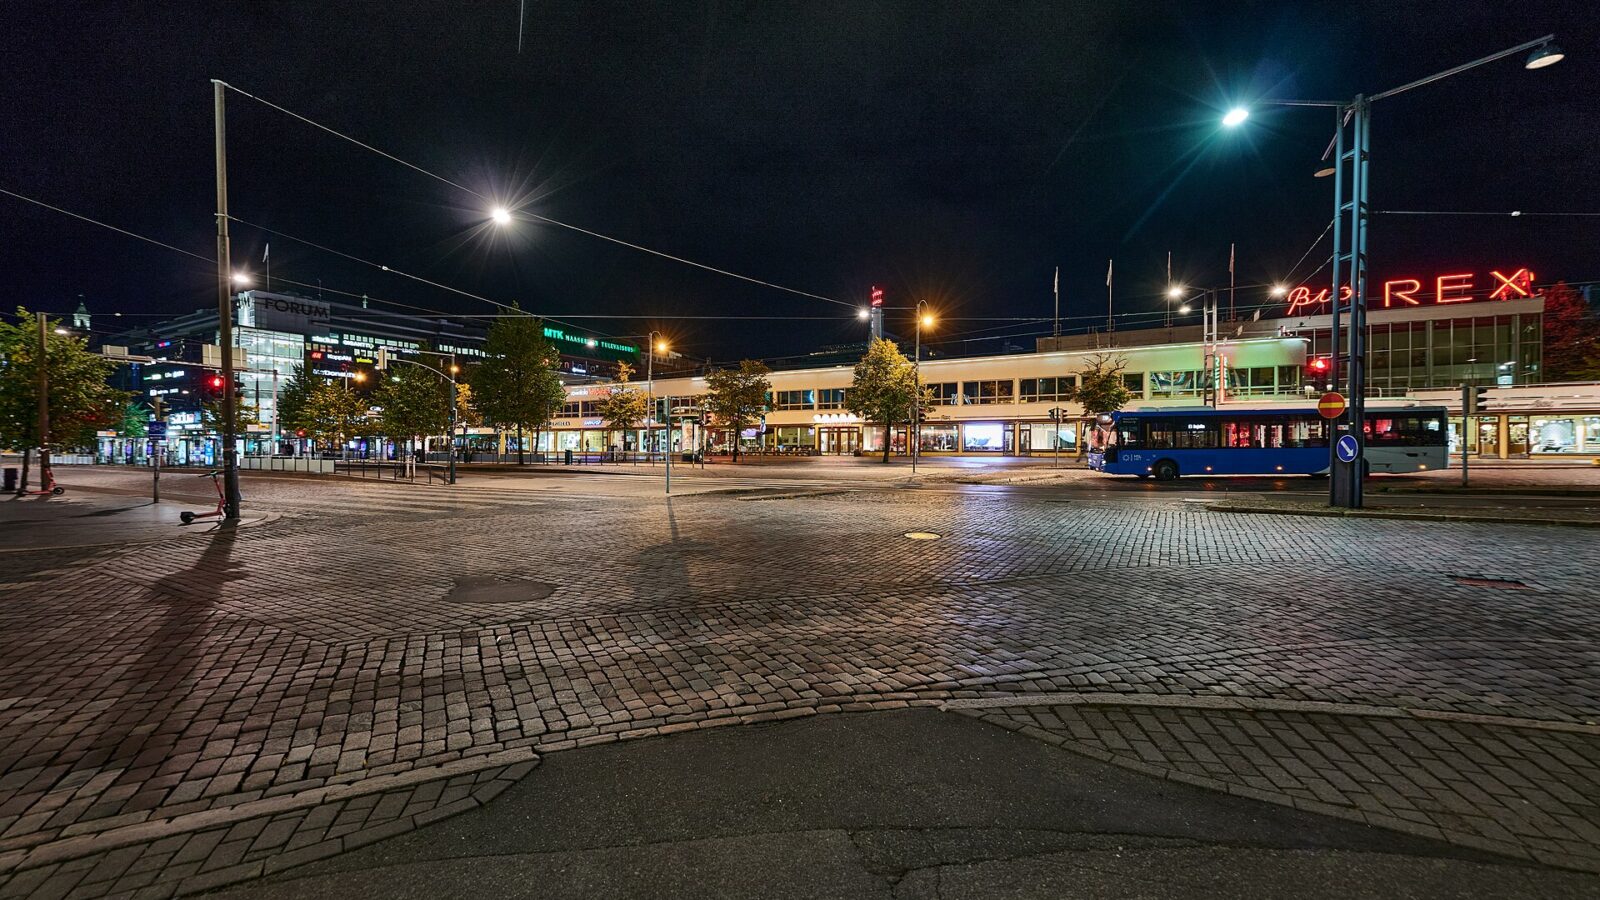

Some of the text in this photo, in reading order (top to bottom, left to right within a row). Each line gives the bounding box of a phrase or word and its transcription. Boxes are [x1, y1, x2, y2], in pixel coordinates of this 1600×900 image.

[1384, 268, 1529, 307] REX
[265, 297, 328, 318] FORUM
[544, 328, 564, 339] MTK
